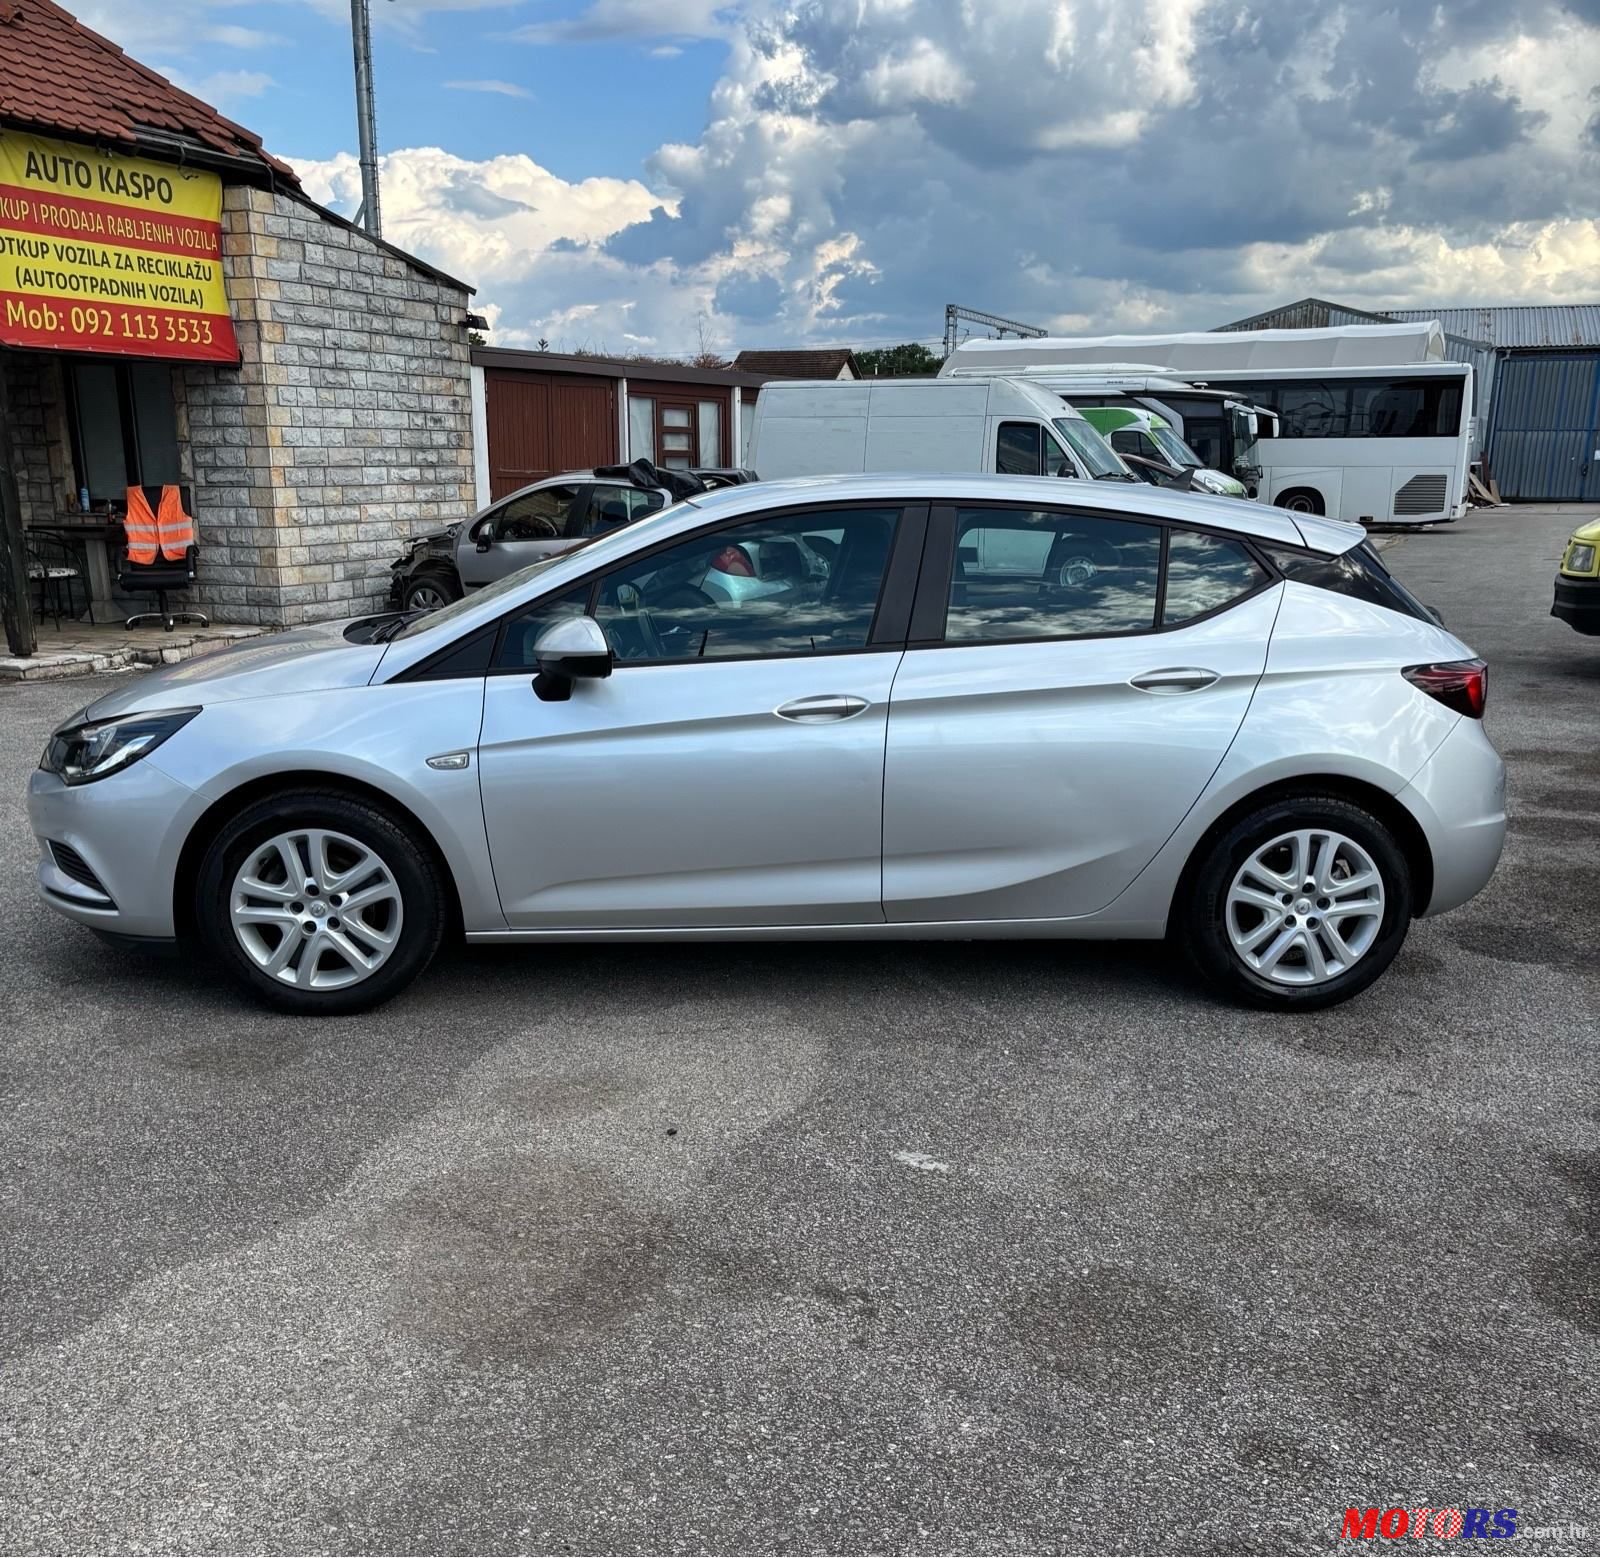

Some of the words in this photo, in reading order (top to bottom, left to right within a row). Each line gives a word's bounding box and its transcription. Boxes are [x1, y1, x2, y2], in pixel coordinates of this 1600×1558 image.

[25, 151, 92, 189] AUTO
[98, 164, 173, 204] KASPO
[32, 203, 38, 224] I
[40, 204, 105, 235] PRODAJA
[107, 215, 175, 246] RABLJENIH
[175, 228, 218, 252] VOZILA
[53, 243, 111, 268] VOZILA
[113, 253, 134, 272] ZA
[137, 256, 212, 282] RECIKLAŽU
[15, 266, 147, 300] (AUTOOTPADNIH
[149, 284, 204, 309] VOZILA)
[6, 299, 65, 332] Mob:
[71, 306, 114, 336] 092
[120, 313, 159, 340] 113
[164, 317, 213, 345] 3533
